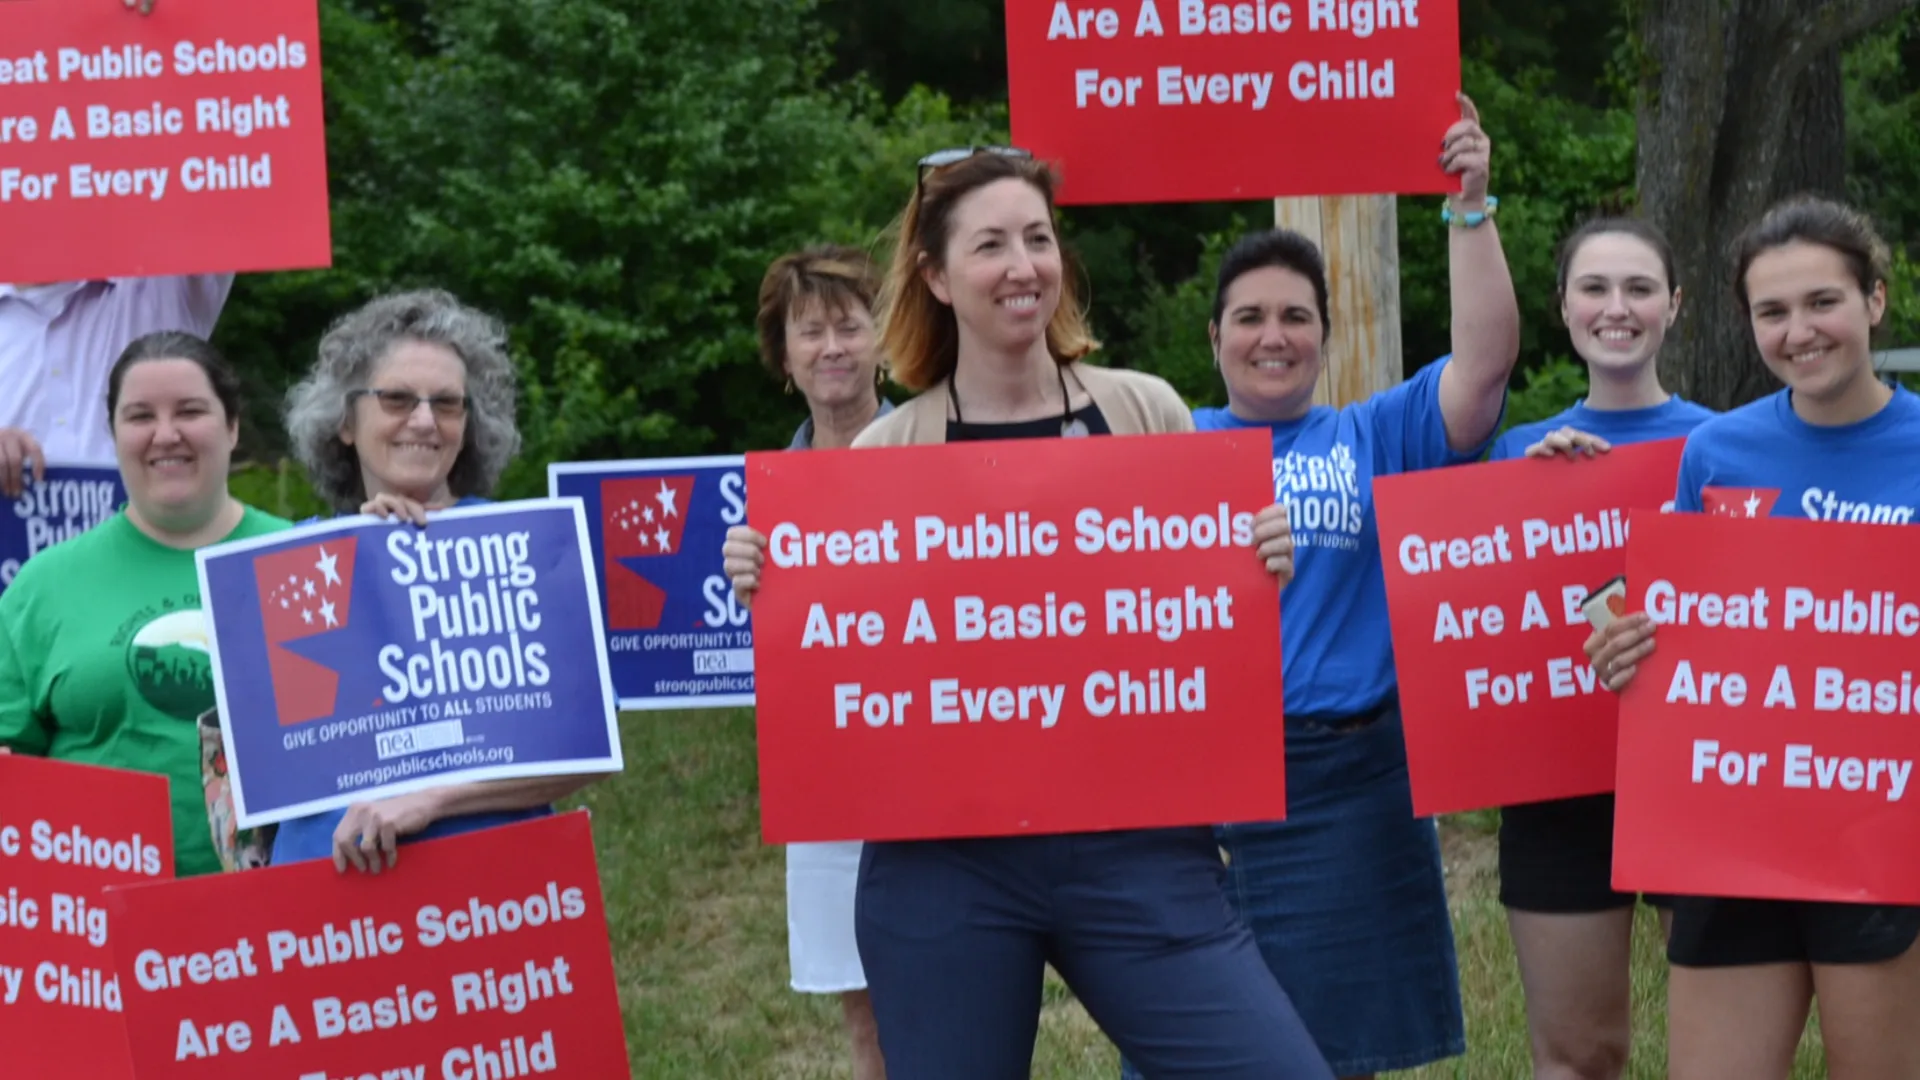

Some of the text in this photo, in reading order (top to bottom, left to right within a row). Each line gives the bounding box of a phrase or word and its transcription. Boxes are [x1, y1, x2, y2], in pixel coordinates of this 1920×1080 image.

[1047, 0, 1419, 41] Are A Basic Right
[58, 43, 164, 81] Public
[174, 35, 307, 73] Schools
[1075, 59, 1395, 110] For Every Child
[0, 95, 291, 143] re A Basic Right
[0, 154, 272, 201] For Every Child
[387, 530, 536, 587] Strong
[769, 502, 1254, 568] Great Public Schools
[1399, 508, 1630, 575] Great Publi
[409, 577, 541, 642] Public
[800, 585, 1234, 648] Are A Basic Right
[1433, 602, 1505, 643] Are
[1521, 590, 1550, 631] A
[1644, 579, 1769, 629] Great
[1783, 586, 1919, 637] Public
[378, 631, 551, 703] Schools
[610, 631, 752, 651] GIVE OPPORTUNITY TO
[834, 667, 1207, 729] For Every Child
[1465, 668, 1533, 710] For
[1665, 660, 1747, 706] Are
[1763, 665, 1796, 710] A
[1813, 666, 1920, 715] Basi
[283, 727, 317, 751] GIVE
[319, 706, 418, 743] OPPORTUNITY
[420, 703, 440, 720] TO
[444, 699, 473, 717] ALL
[475, 692, 553, 714] STUDENTS
[336, 746, 515, 790] strongpublicschools.org
[1691, 739, 1913, 801] For Every
[30, 819, 162, 876] Schools
[134, 882, 586, 993] Great Public Schools
[34, 960, 124, 1012] Child
[174, 956, 573, 1062] Are A Basic Right
[440, 1031, 557, 1080] Child
